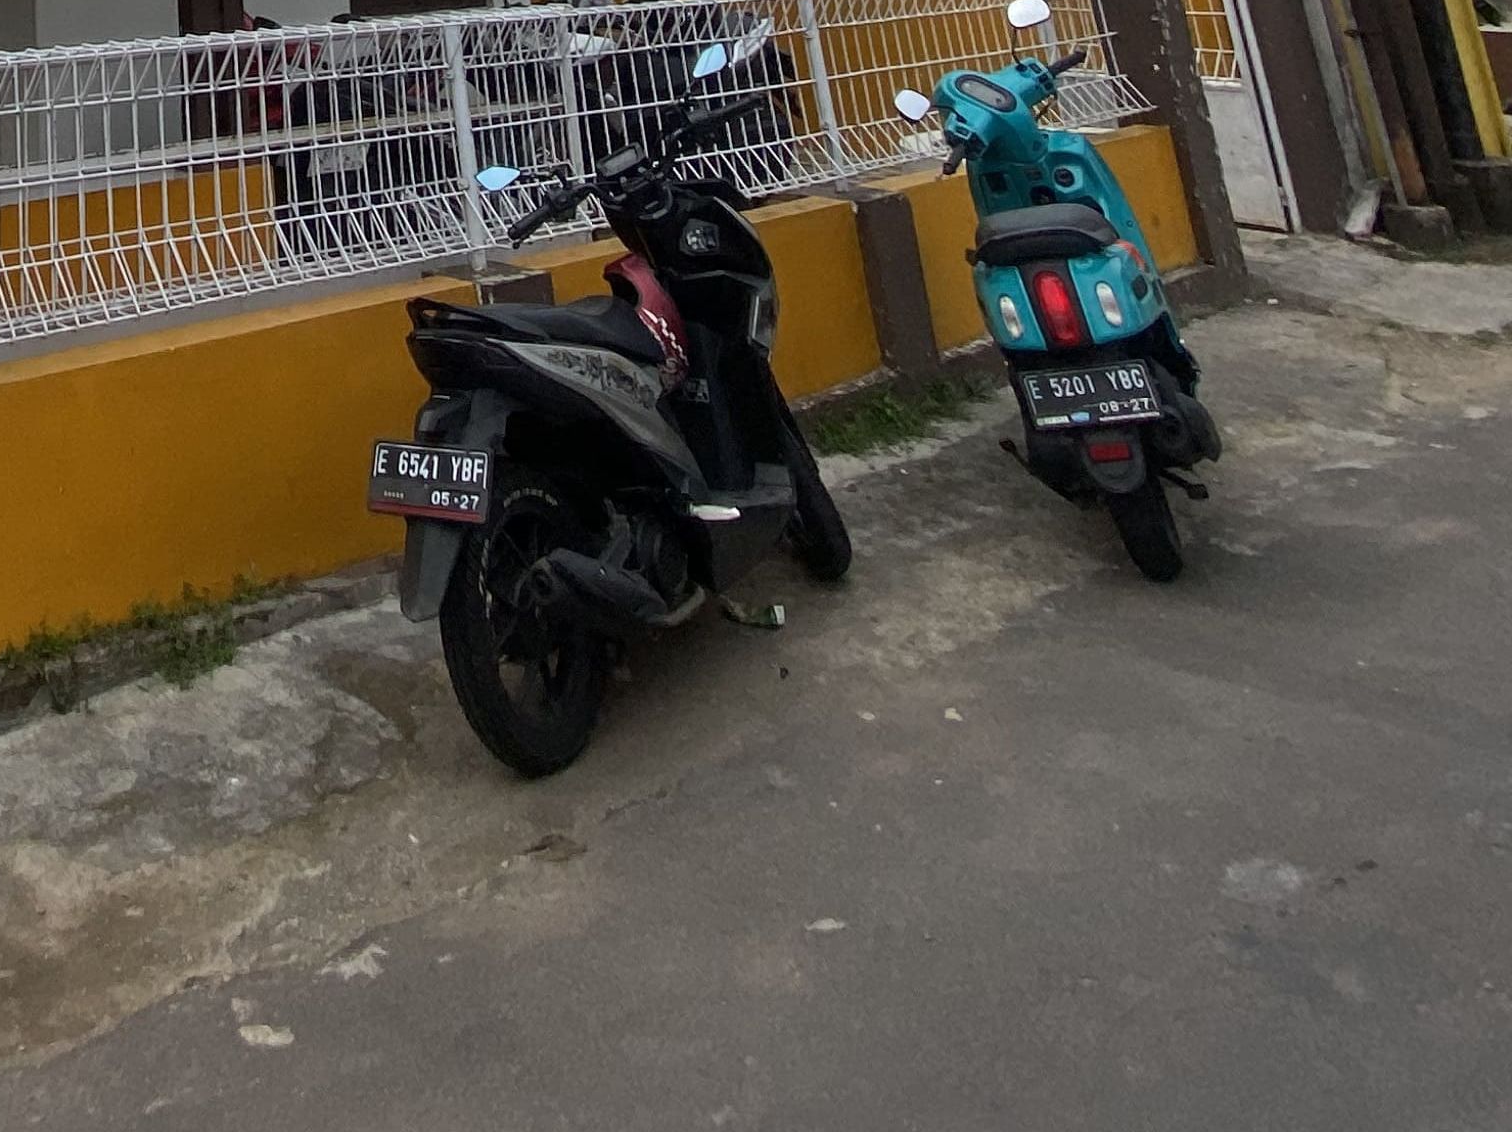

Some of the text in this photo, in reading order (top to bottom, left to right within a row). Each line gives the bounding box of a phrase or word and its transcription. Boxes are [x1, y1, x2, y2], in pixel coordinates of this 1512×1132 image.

[1028, 369, 1144, 400] E 5201 YBG
[377, 449, 484, 483] E 6541 YBF
